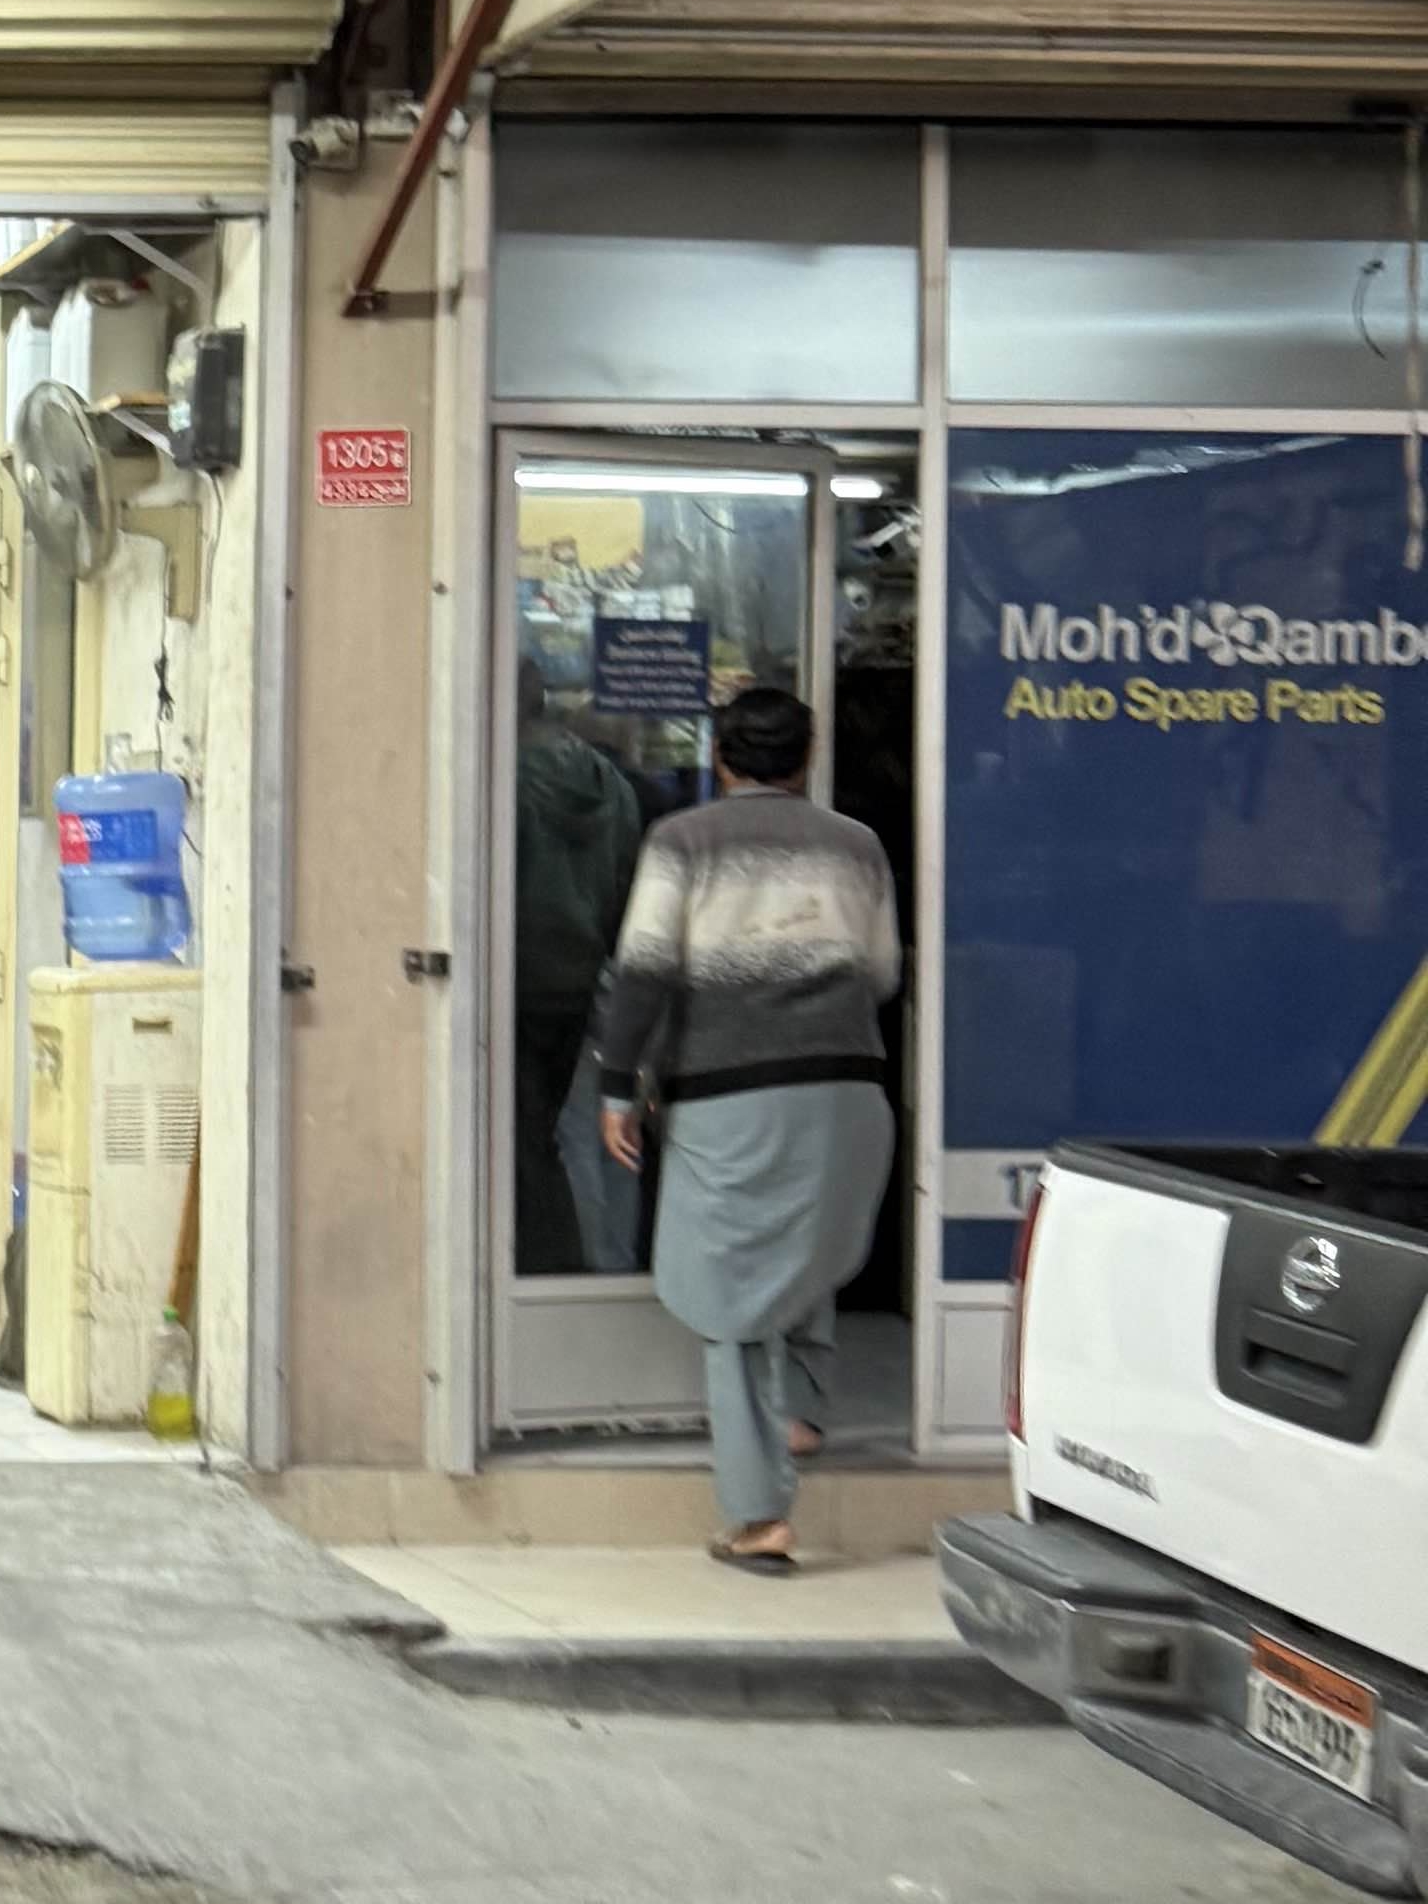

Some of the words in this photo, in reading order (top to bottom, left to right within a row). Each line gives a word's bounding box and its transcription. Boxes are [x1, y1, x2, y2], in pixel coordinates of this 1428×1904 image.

[1001, 602, 1191, 664] Moh'd
[1238, 604, 1428, 666] Qamb
[1004, 677, 1118, 721] Auto
[1123, 677, 1259, 733] Spare
[1266, 678, 1386, 724] Parts
